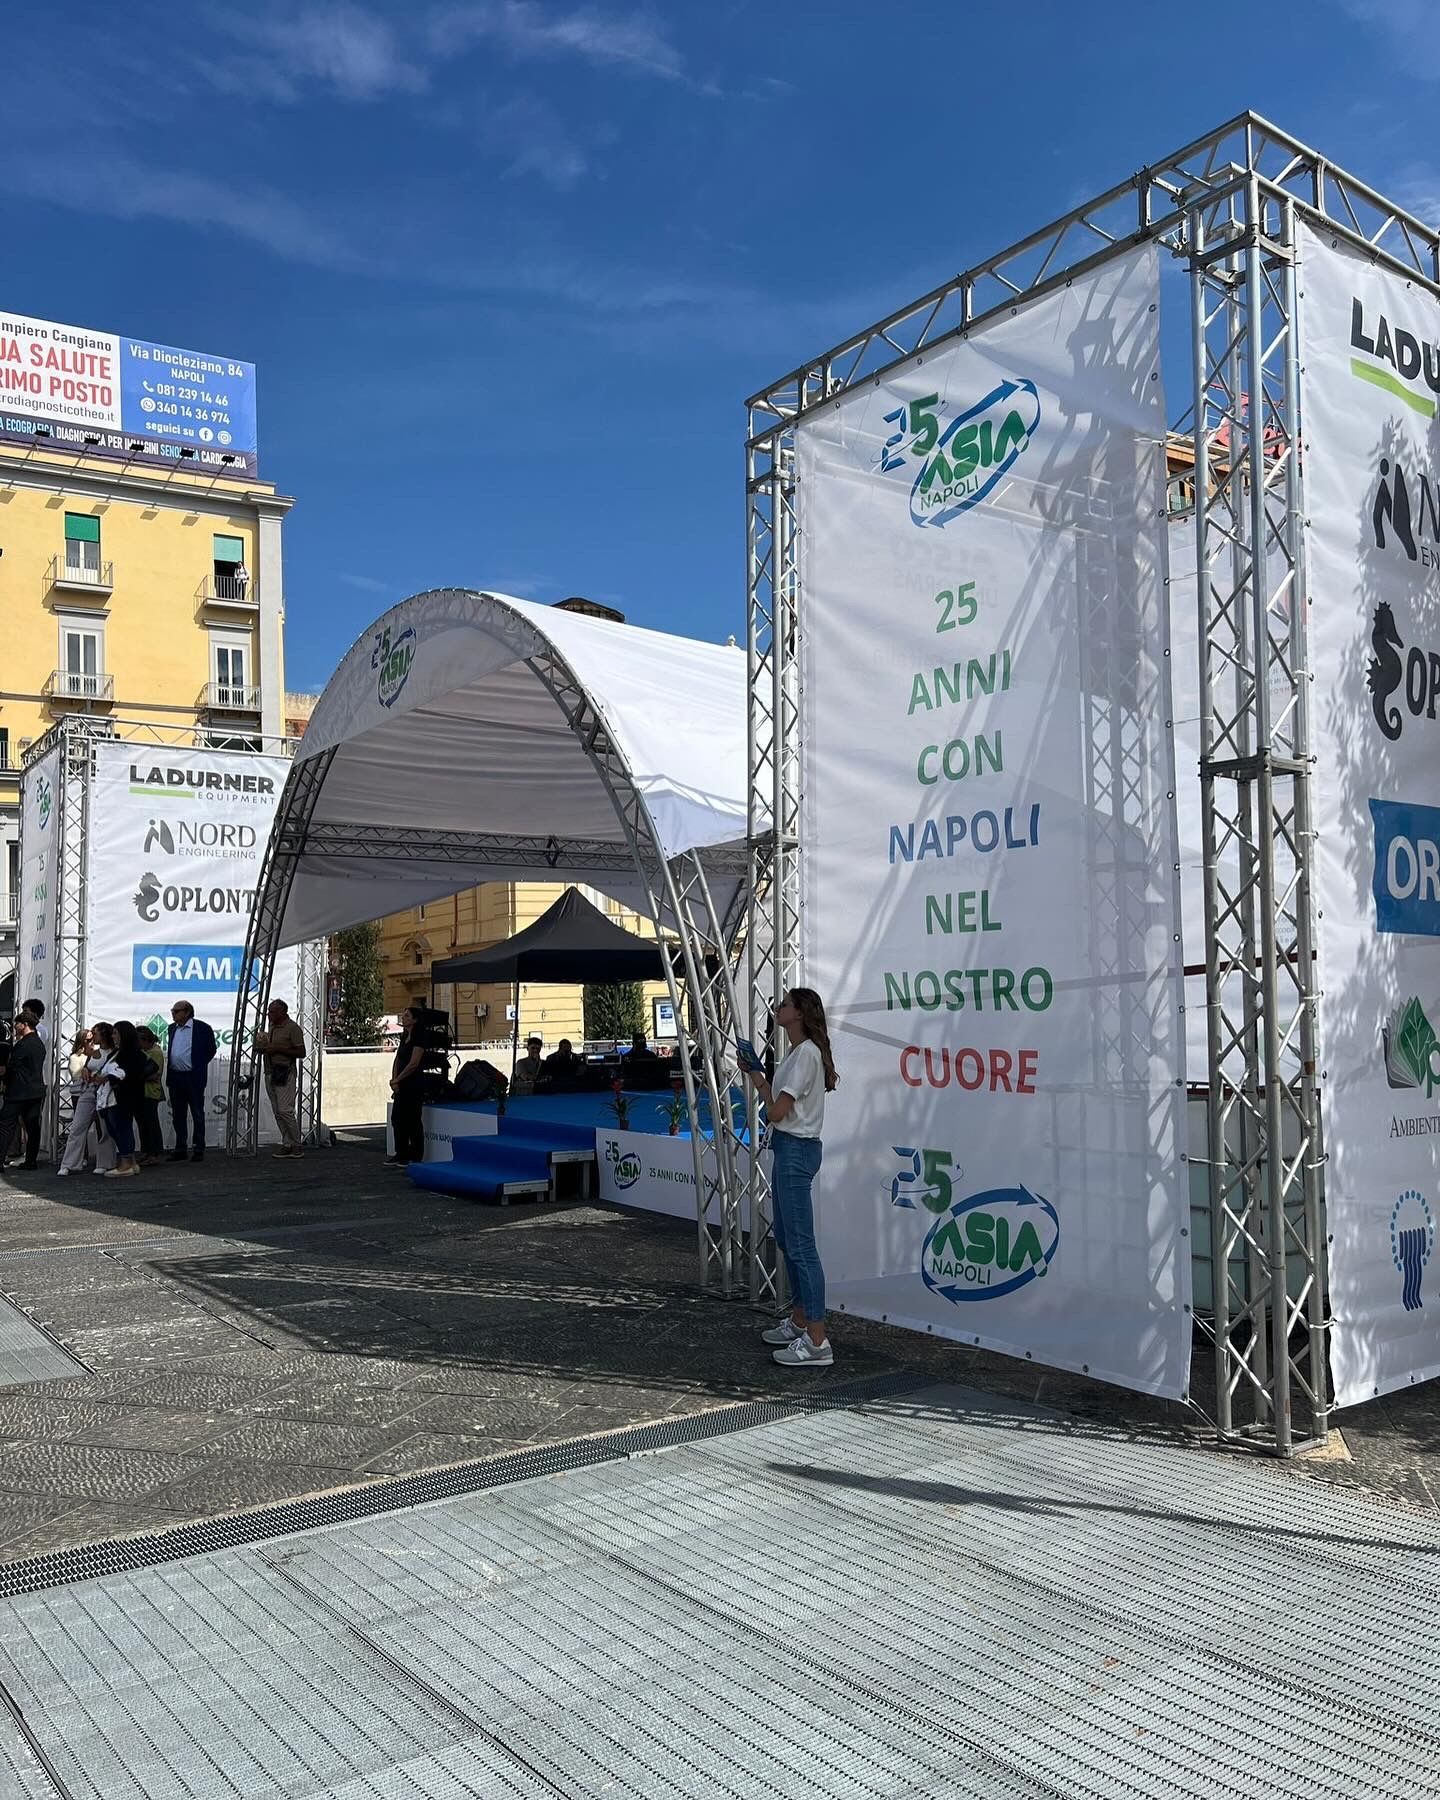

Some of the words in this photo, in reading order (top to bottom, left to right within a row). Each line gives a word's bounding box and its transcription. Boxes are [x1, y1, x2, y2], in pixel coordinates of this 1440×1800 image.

[1, 322, 47, 338] mpiero
[52, 329, 112, 351] Cangiano
[1351, 296, 1440, 393] LADU
[30, 343, 111, 380] SALUTE
[130, 344, 149, 360] Via
[153, 349, 225, 375] Diocleziano,
[228, 364, 243, 377] 84
[171, 368, 205, 384] NAPOLI
[49, 376, 113, 407] POSTO
[157, 384, 175, 396] 081
[179, 387, 197, 401] 239
[201, 391, 212, 404] 14
[215, 396, 229, 407] 46
[145, 421, 181, 436] seguici
[183, 428, 195, 437] su
[156, 402, 178, 416] 340
[181, 406, 193, 418] 14
[195, 409, 208, 421] 36
[211, 411, 230, 425] 974
[107, 435, 123, 449] PER
[879, 392, 938, 472] 25
[920, 410, 1030, 494] ASIA
[920, 475, 979, 511] NAPOLI
[935, 581, 978, 634] 25
[907, 649, 1011, 715] ANNI
[917, 730, 1003, 785] CON
[129, 765, 275, 795] LADURNER
[198, 791, 276, 805] EQUIPMENT
[177, 820, 257, 848] NORD
[889, 803, 1040, 865] NAPOLI
[178, 847, 256, 860] ENGINEERING
[1387, 835, 1440, 902] OR
[162, 885, 265, 914] OPLONT
[926, 889, 1002, 934] NEL
[884, 967, 1053, 1012] NOSTRO
[900, 1046, 1038, 1094] CUORE
[650, 1168, 656, 1177] 25
[657, 1171, 673, 1181] ANNI
[674, 1172, 689, 1183] CON
[891, 1146, 953, 1214] 25
[931, 1211, 1048, 1277] ASIA
[932, 1258, 991, 1285] NAPOLI
